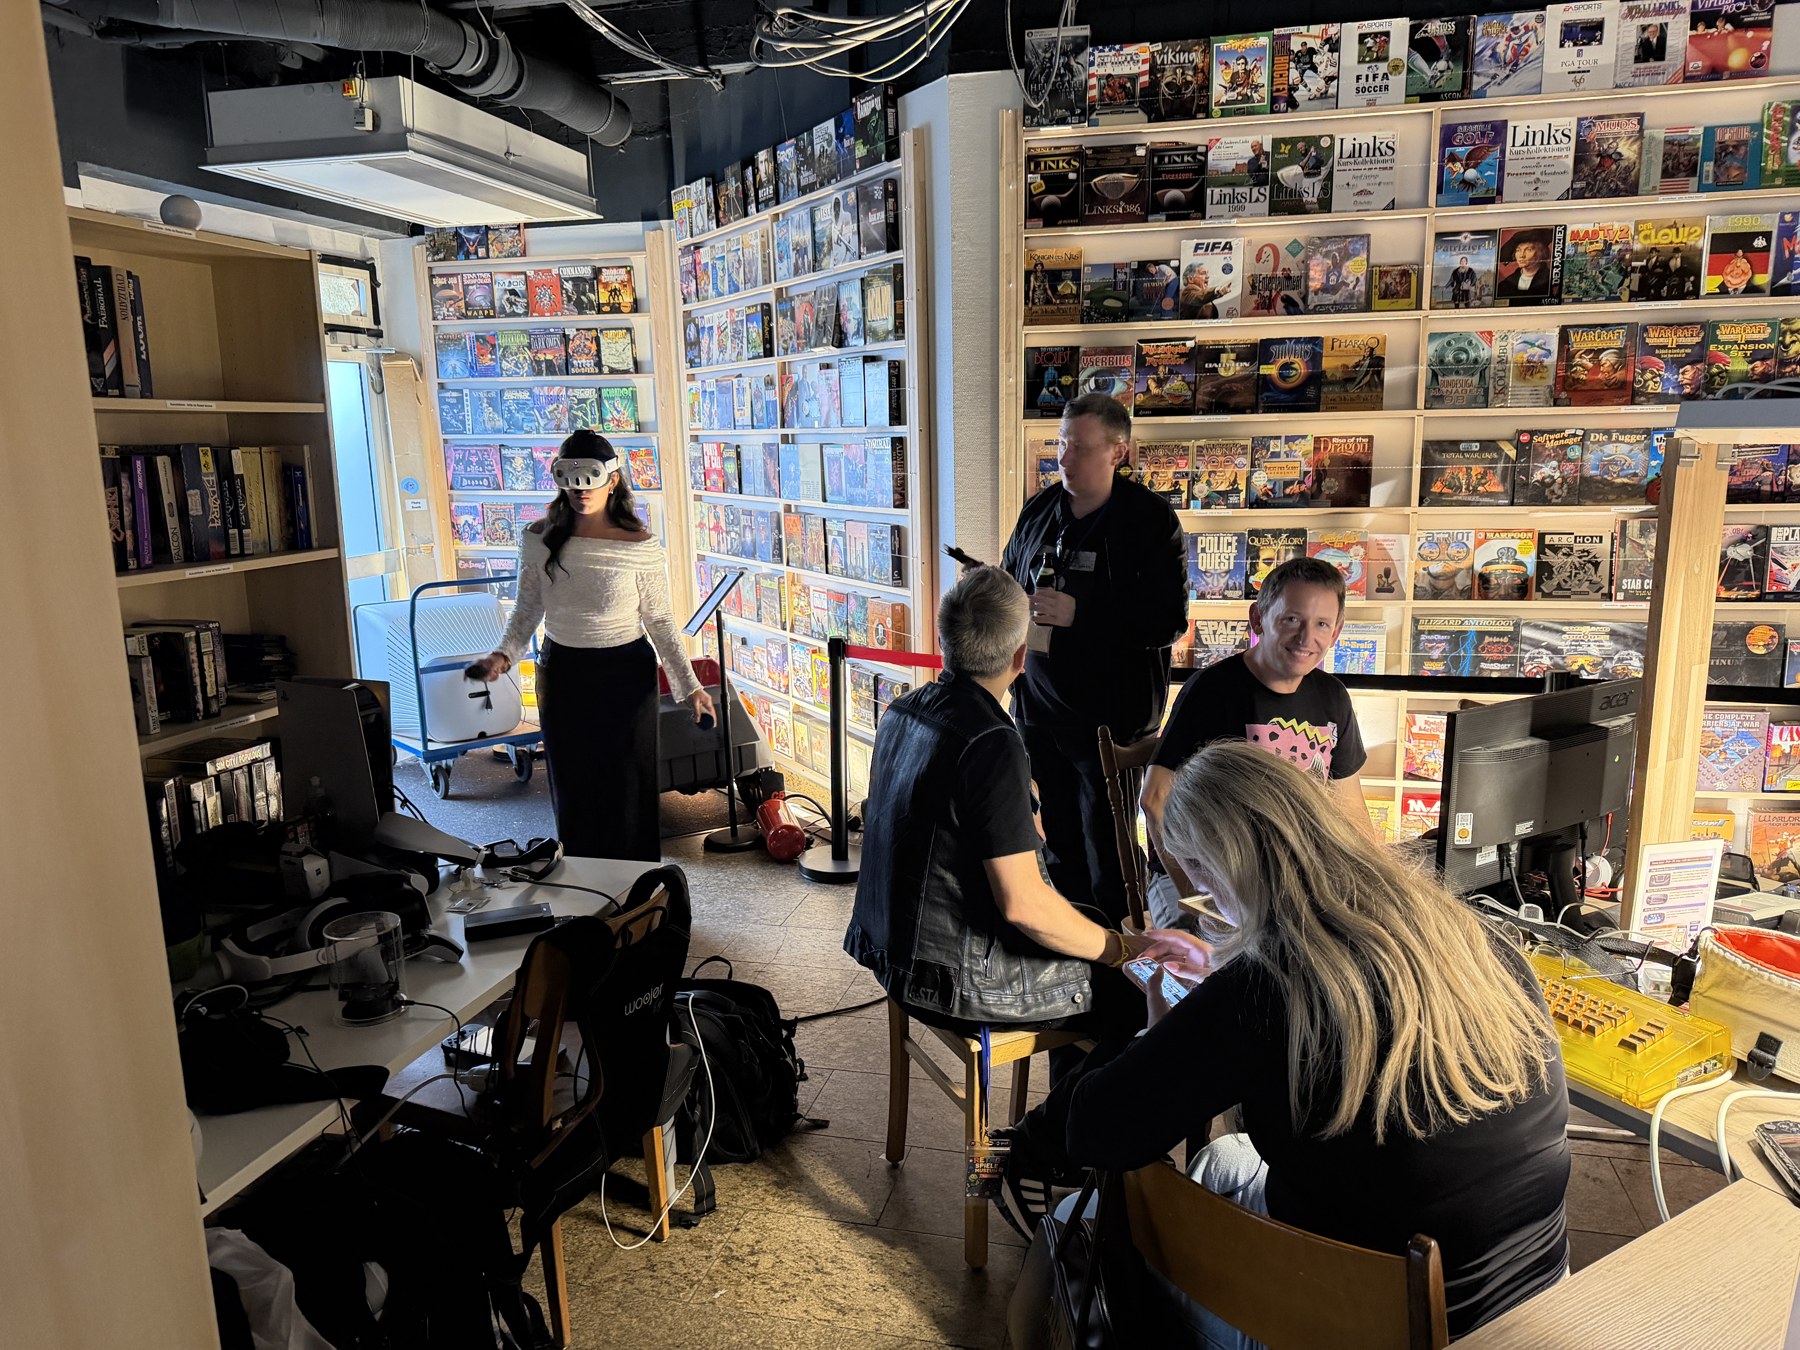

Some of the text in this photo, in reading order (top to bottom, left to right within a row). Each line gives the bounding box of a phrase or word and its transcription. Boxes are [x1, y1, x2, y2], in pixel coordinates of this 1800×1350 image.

[1574, 3, 1602, 11] SPORTS
[1273, 56, 1289, 97] HOCKEY
[1356, 73, 1390, 83] FIFA
[1355, 84, 1390, 94] SOCCER
[1440, 92, 1462, 100] ASCON
[1452, 131, 1495, 145] GOLF
[1511, 123, 1572, 148] Links
[1338, 137, 1396, 160] Links
[1030, 158, 1080, 173] LINKS
[1153, 152, 1206, 166] LINKS
[1209, 186, 1268, 206] Links LS
[1085, 203, 1120, 216] LINKS
[1228, 204, 1246, 213] 1999
[1638, 223, 1653, 231] DER
[1728, 216, 1761, 226] 1990
[1570, 224, 1630, 242] MAD TV 2
[1638, 226, 1702, 245] CLOU! 2
[1193, 241, 1233, 253] FIFA
[559, 266, 593, 276] COMMANDOS
[1552, 264, 1562, 285] DER
[116, 273, 130, 322] CIVILIZATION
[1570, 327, 1626, 342] WARCRAFT
[1649, 325, 1699, 338] WARCRAFT
[1720, 323, 1769, 335] WARCRAFT
[1331, 337, 1380, 352] PHARAO
[1710, 343, 1775, 351] EXPANSION
[1082, 354, 1132, 367] YSERBIUS
[1440, 379, 1474, 388] BUNDESLIGA
[1430, 388, 1484, 397] MANAGER
[1443, 396, 1466, 405] 98
[1533, 432, 1569, 444] Software
[1545, 436, 1583, 448] Manager
[1589, 432, 1647, 444] Die Fugger
[1319, 438, 1369, 457] Dragon
[1248, 535, 1305, 546] QUEST GLORY
[1486, 532, 1534, 540] HARPOON
[1548, 536, 1600, 544] ARCHON
[174, 526, 183, 562] FALCON
[1197, 536, 1238, 554] POLICE
[1197, 553, 1236, 572] QUEST
[1622, 580, 1643, 591] STAR
[1196, 621, 1248, 635] SPACE
[1419, 618, 1515, 627] BLIZZARD ANTHOLOGY
[1200, 634, 1241, 646] QUEST
[1599, 692, 1630, 711] acer
[1743, 720, 1760, 728] WAR
[1779, 726, 1800, 741] CAS
[1407, 799, 1440, 813] M.A
[624, 982, 664, 1016] woojer
[909, 985, 939, 1005] G-STA
[974, 1156, 1000, 1164] RETRO
